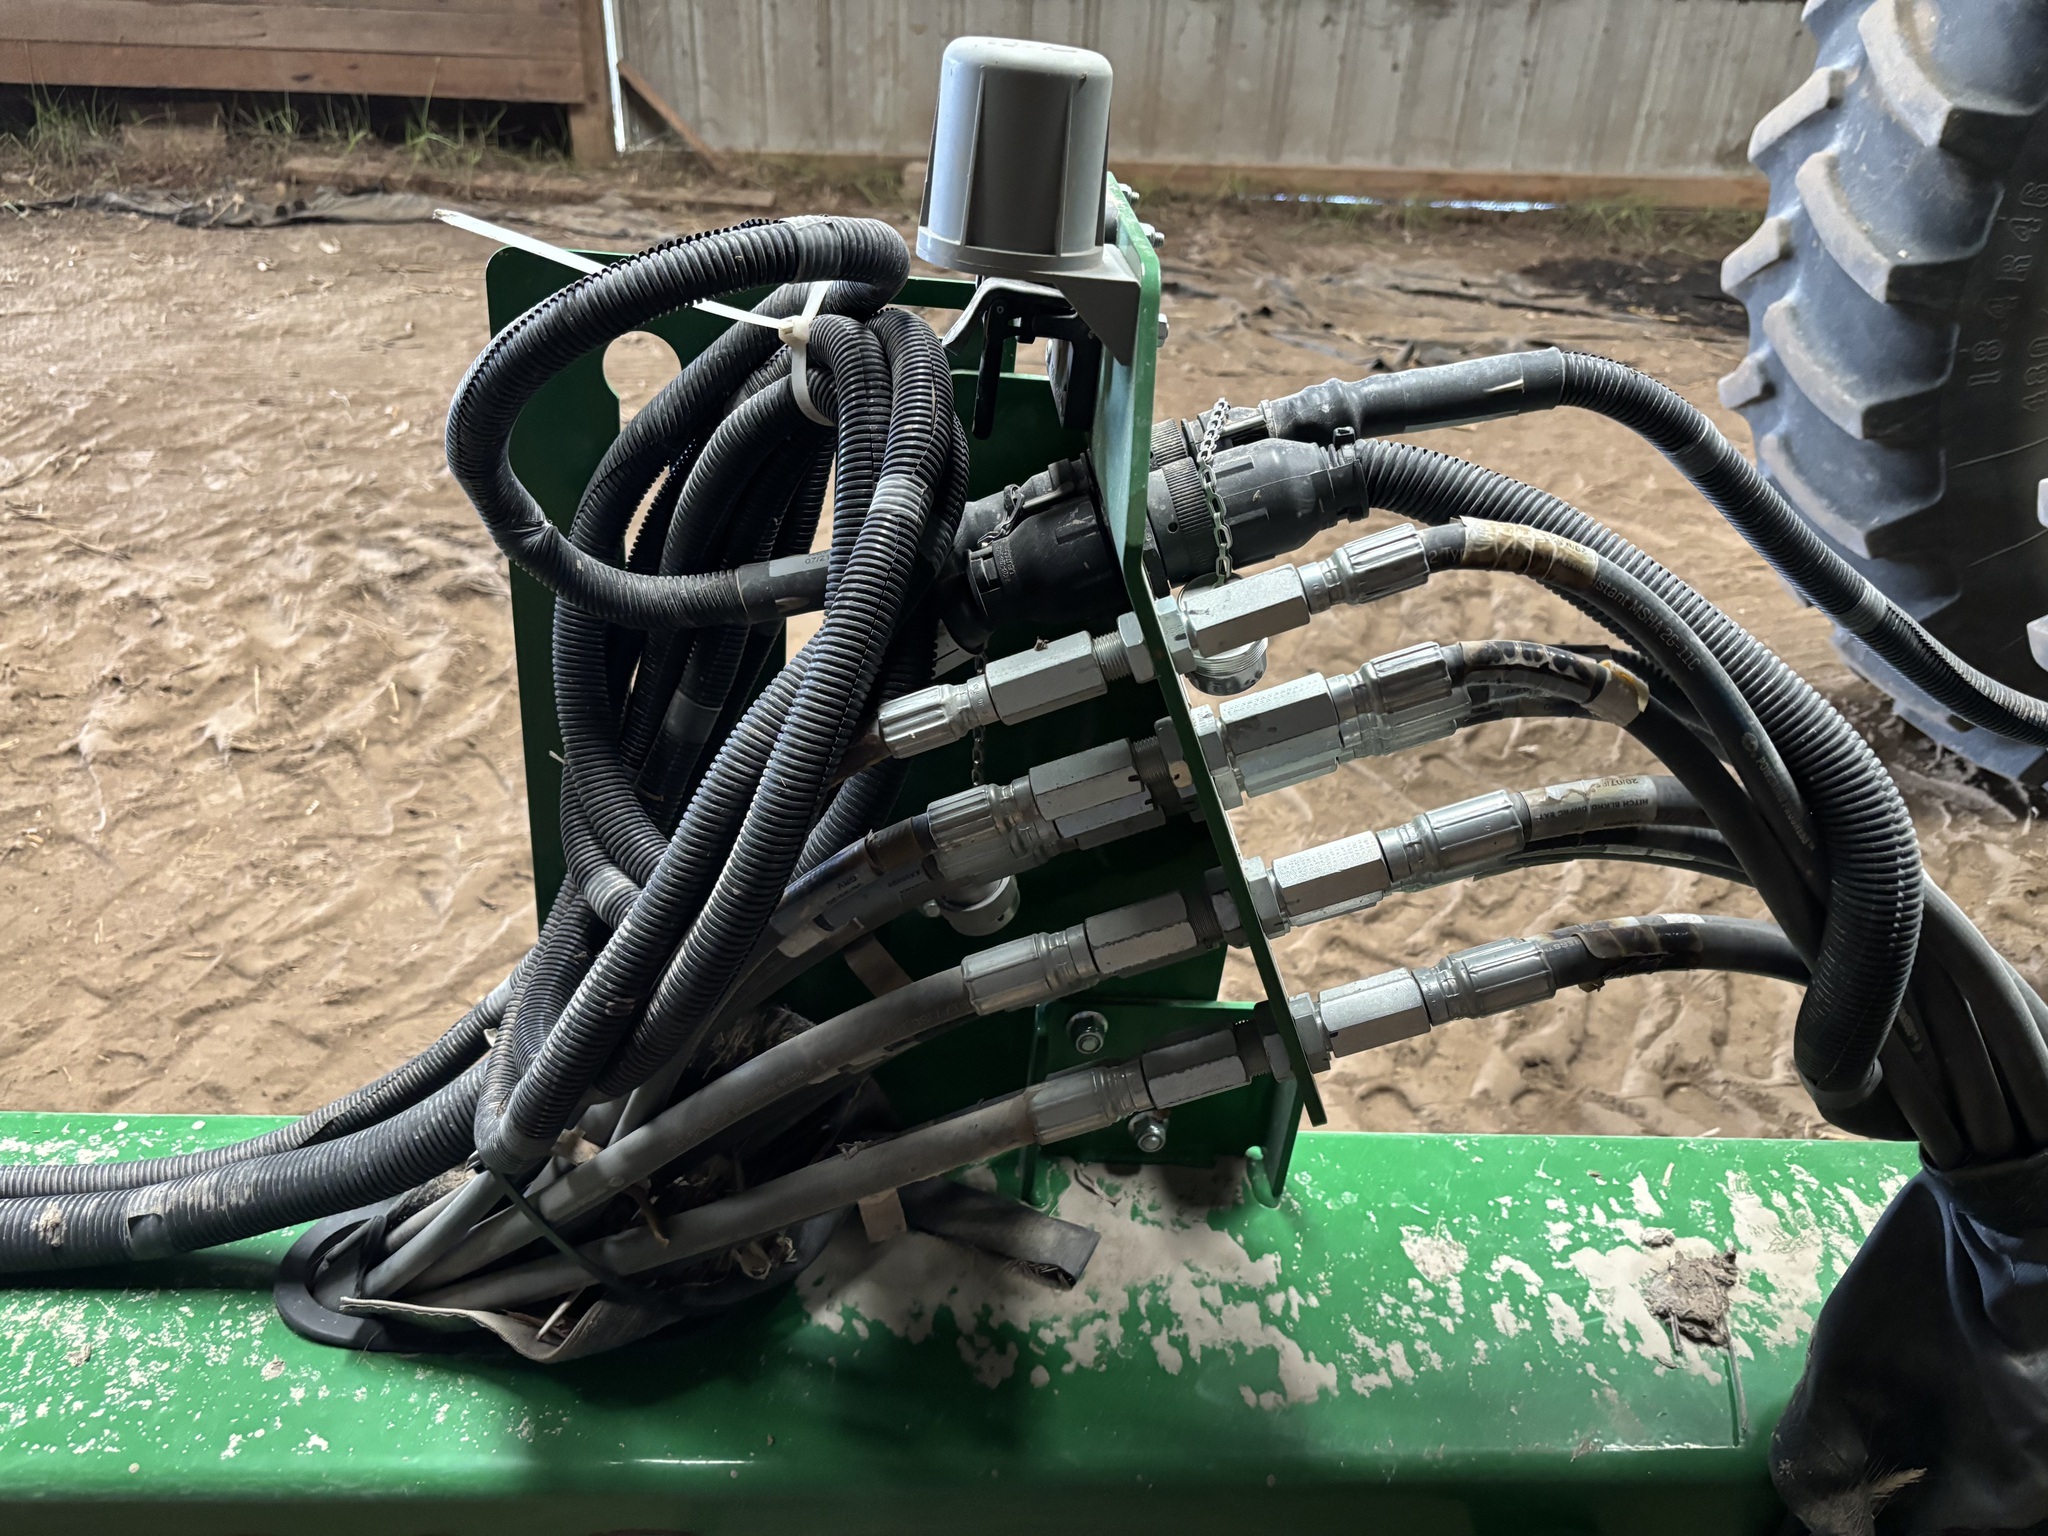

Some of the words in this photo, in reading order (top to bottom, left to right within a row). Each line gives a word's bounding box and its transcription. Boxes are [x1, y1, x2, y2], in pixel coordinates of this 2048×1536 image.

[1428, 550, 1439, 564] 2
[1593, 574, 1630, 607] istant
[1628, 599, 1664, 634] MSHA
[1659, 626, 1701, 671] 2G-11C
[1622, 798, 1649, 808] HITCH
